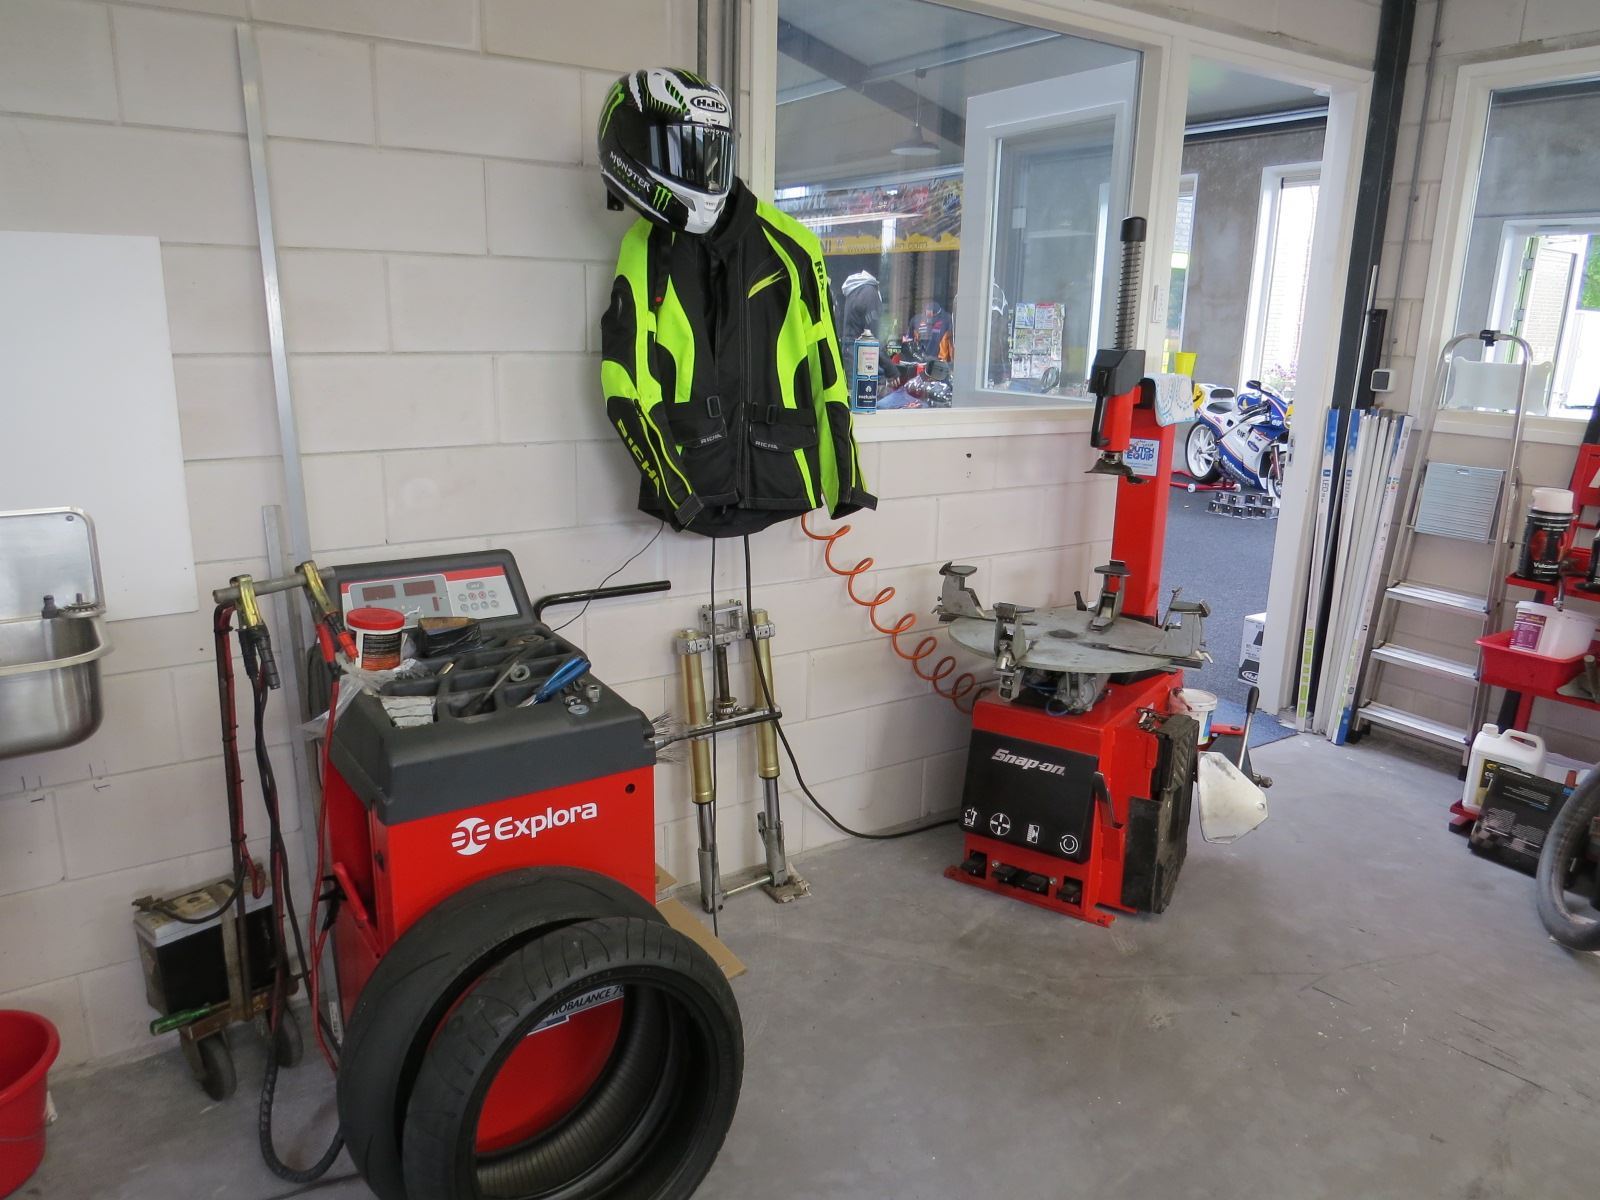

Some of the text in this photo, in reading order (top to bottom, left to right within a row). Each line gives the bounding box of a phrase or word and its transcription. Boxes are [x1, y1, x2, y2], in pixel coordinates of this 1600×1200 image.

[696, 99, 724, 110] HJC
[609, 151, 651, 193] MONSTER
[1126, 450, 1154, 461] EQUIP
[991, 748, 1066, 775] Snap-on
[494, 802, 598, 839] Explora
[551, 987, 611, 1016] ROBALANCE
